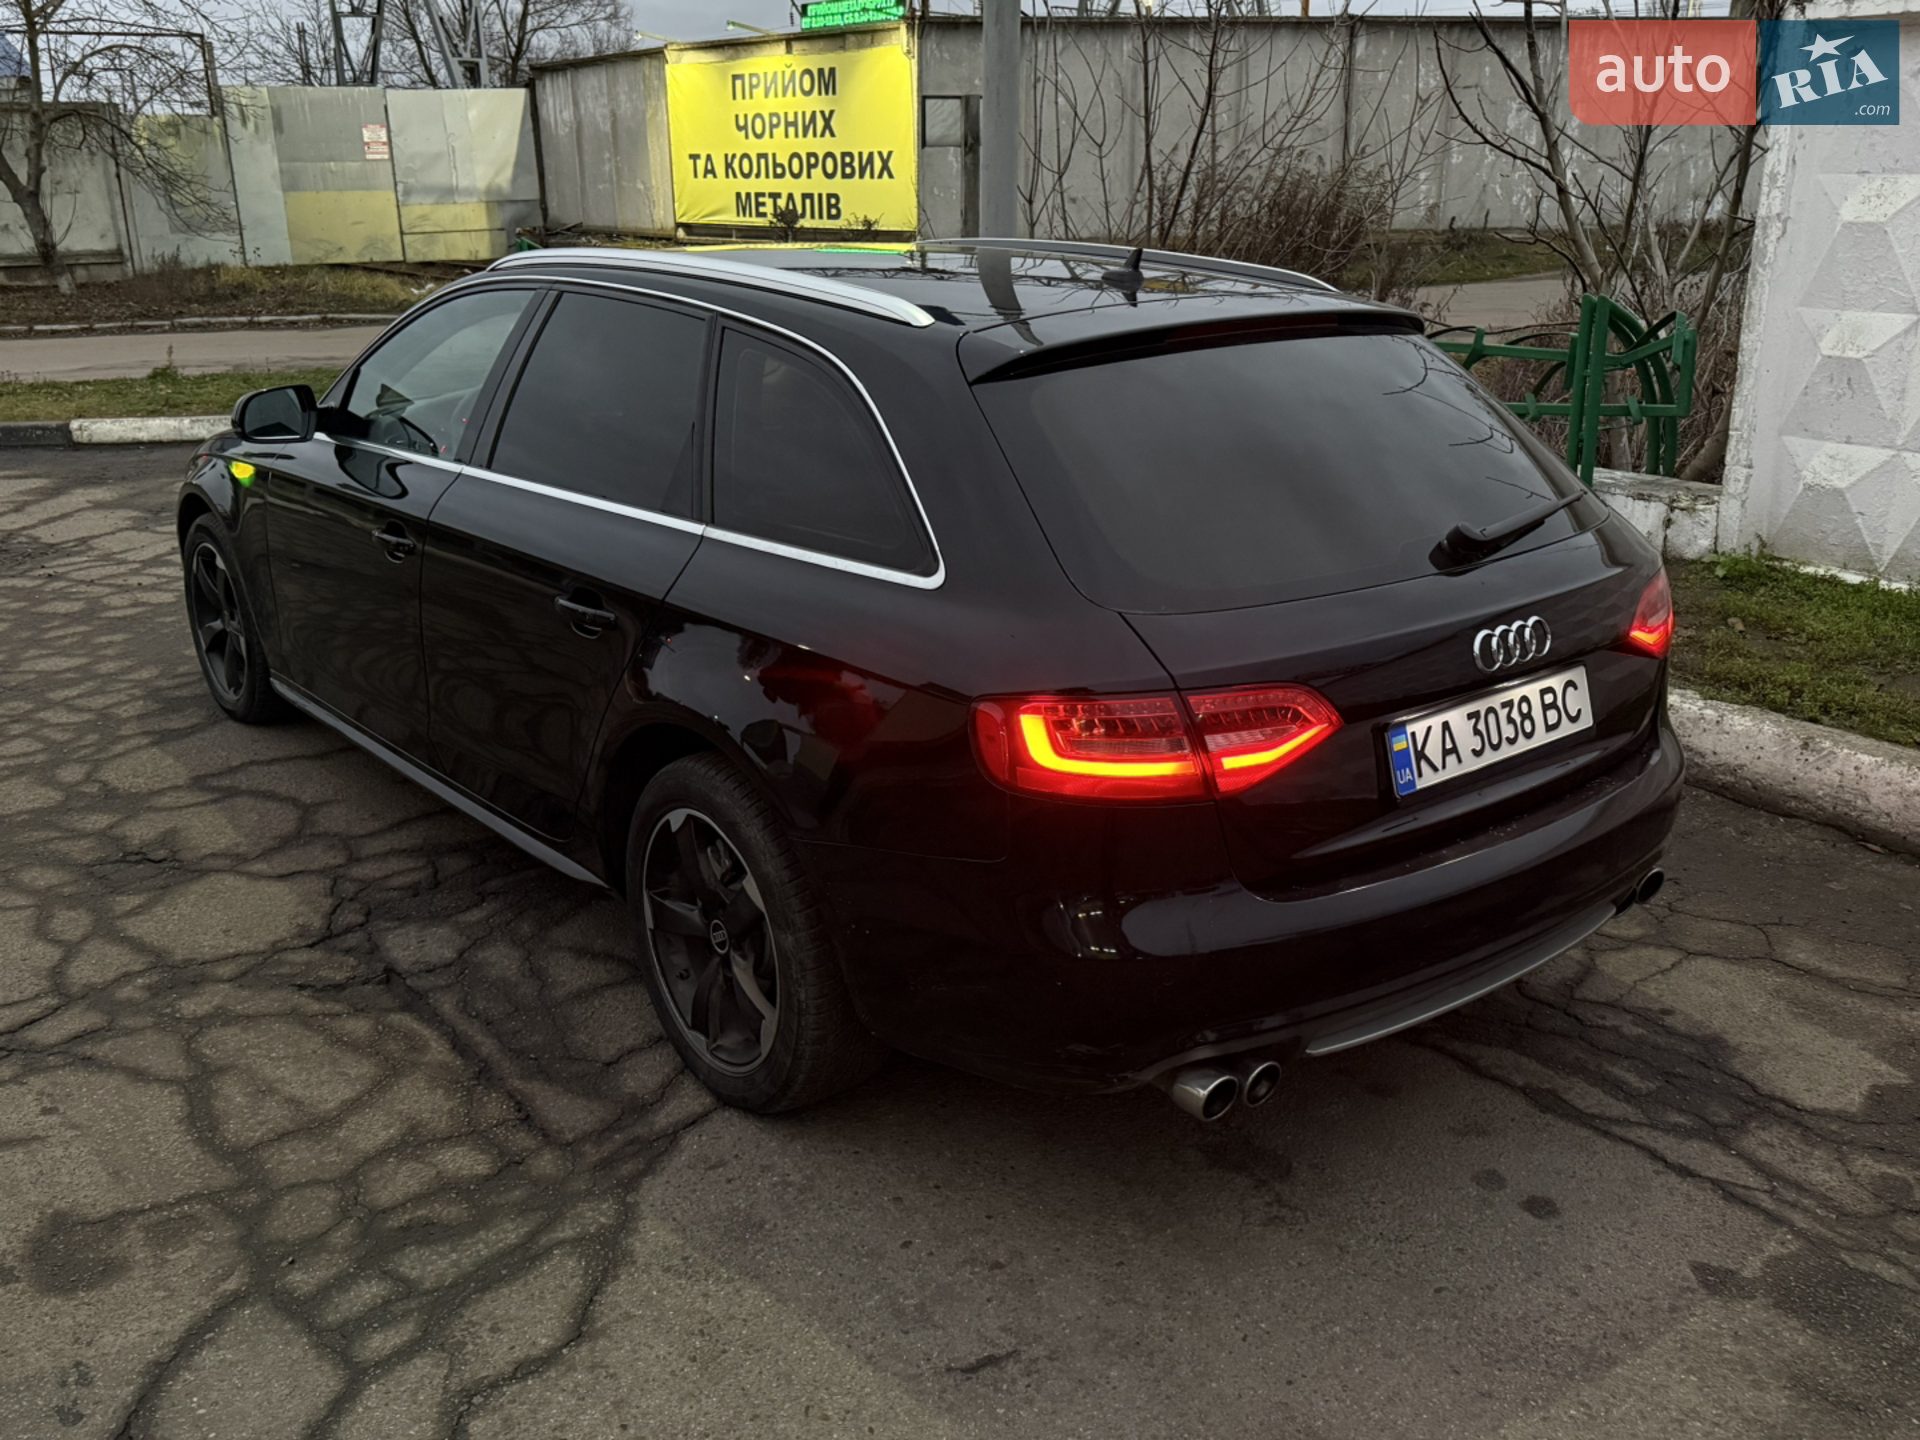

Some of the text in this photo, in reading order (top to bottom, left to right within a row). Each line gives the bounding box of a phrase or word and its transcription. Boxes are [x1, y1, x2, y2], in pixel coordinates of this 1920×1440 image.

[731, 63, 837, 100] ПРИЙОМ
[735, 109, 836, 140] ЧОРНИХ
[688, 150, 895, 180] ТА КОЛЬОРОВИХ
[735, 191, 842, 221] МЕТАЛІВ
[1410, 679, 1582, 778] KA 3038 BC
[1396, 767, 1413, 785] UA
